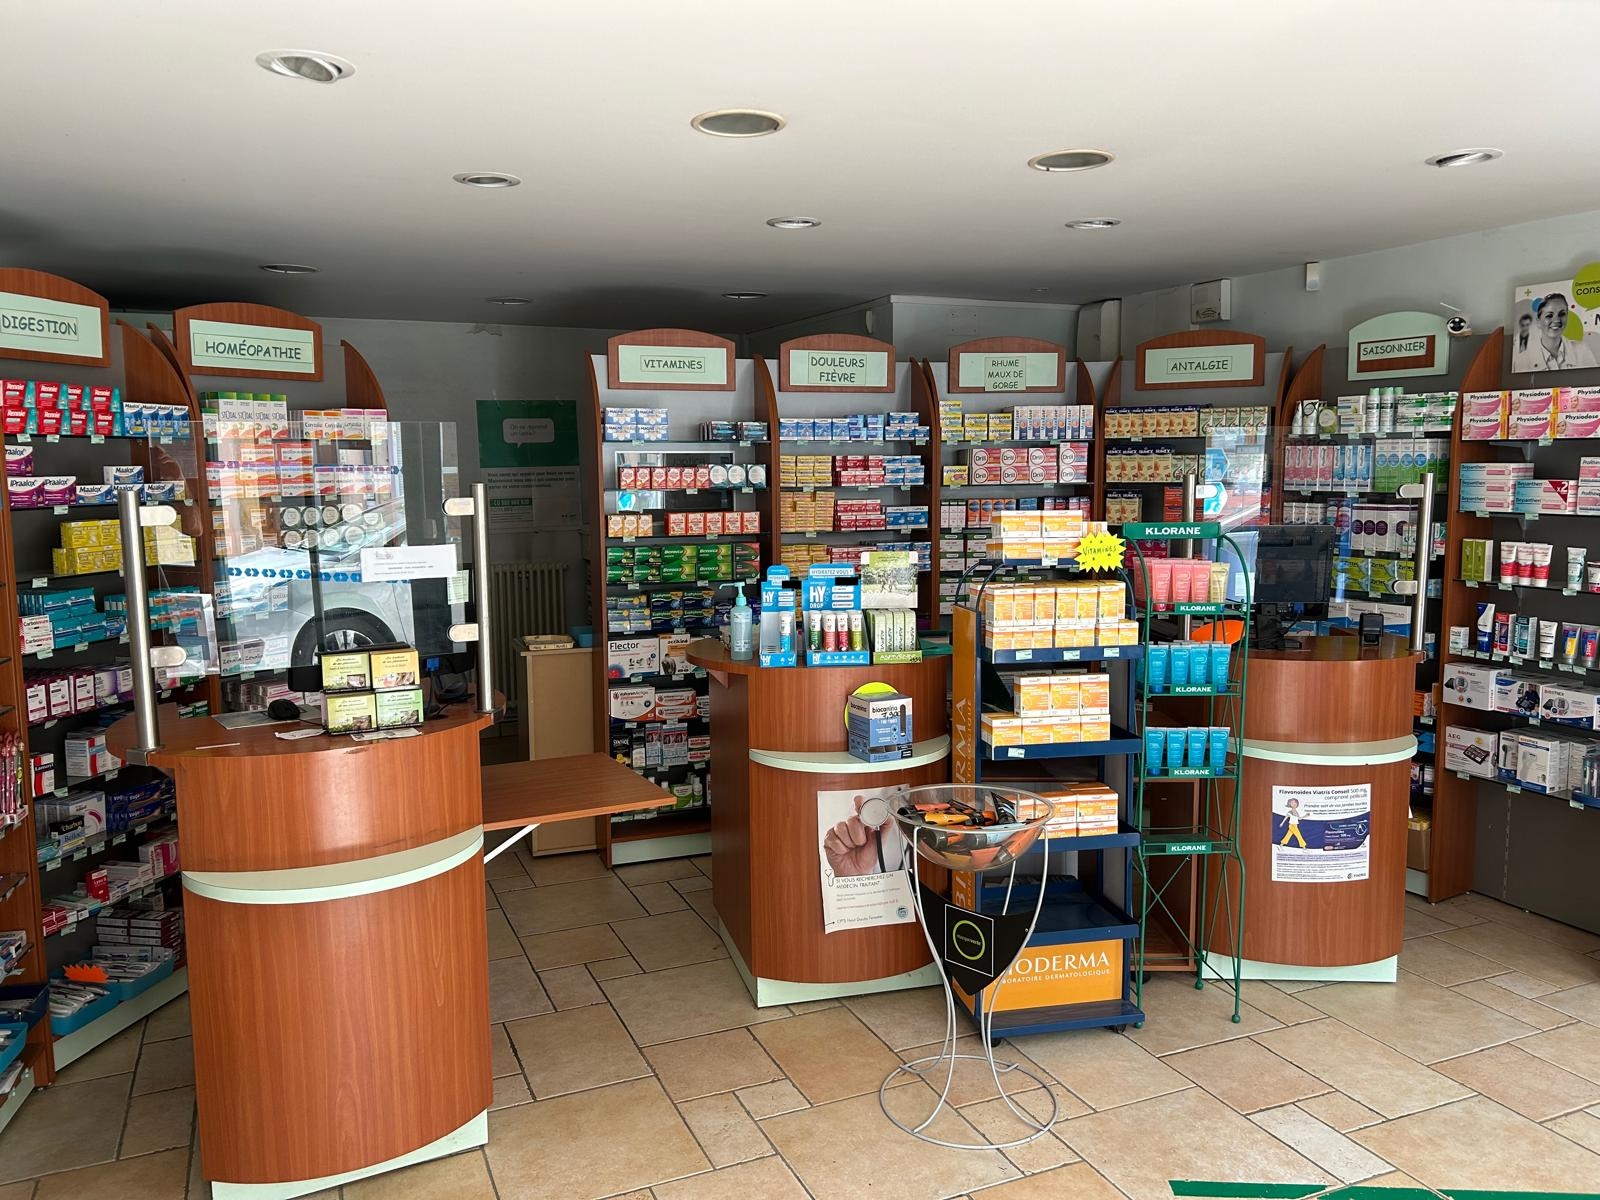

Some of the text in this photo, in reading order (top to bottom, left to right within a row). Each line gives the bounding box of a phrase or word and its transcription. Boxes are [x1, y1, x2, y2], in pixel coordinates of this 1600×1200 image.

[2, 314, 77, 336] DIGESTION
[205, 340, 302, 360] HOMÉOPATHIE
[1361, 342, 1425, 356] SAISONNIER
[644, 359, 703, 370] VITAMINES
[811, 357, 865, 369] DOULEURS
[992, 360, 1019, 368] RHUME
[1171, 359, 1228, 371] ANTALGIE
[819, 370, 856, 383] FIÈVRE
[988, 371, 1024, 380] MAUX DE
[7, 383, 25, 392] Rennie
[40, 385, 58, 394] Rennie
[993, 382, 1019, 391] GORGE
[1469, 393, 1500, 402] Physiodose
[1519, 390, 1551, 399] Physiodose
[7, 411, 26, 420] Rennie
[1516, 415, 1548, 424] Physiodose
[1565, 413, 1599, 422] Physiodose
[1469, 416, 1499, 425] Physiodose
[115, 467, 137, 476] Maalox
[79, 486, 103, 494] Maalox
[1556, 481, 1568, 493] x2
[1145, 526, 1202, 536] KLORANE
[763, 591, 774, 603] HY
[809, 586, 827, 603] HY
[609, 641, 640, 651] Flector
[1447, 732, 1461, 741] AEG
[1008, 952, 1111, 976] ODERMA
